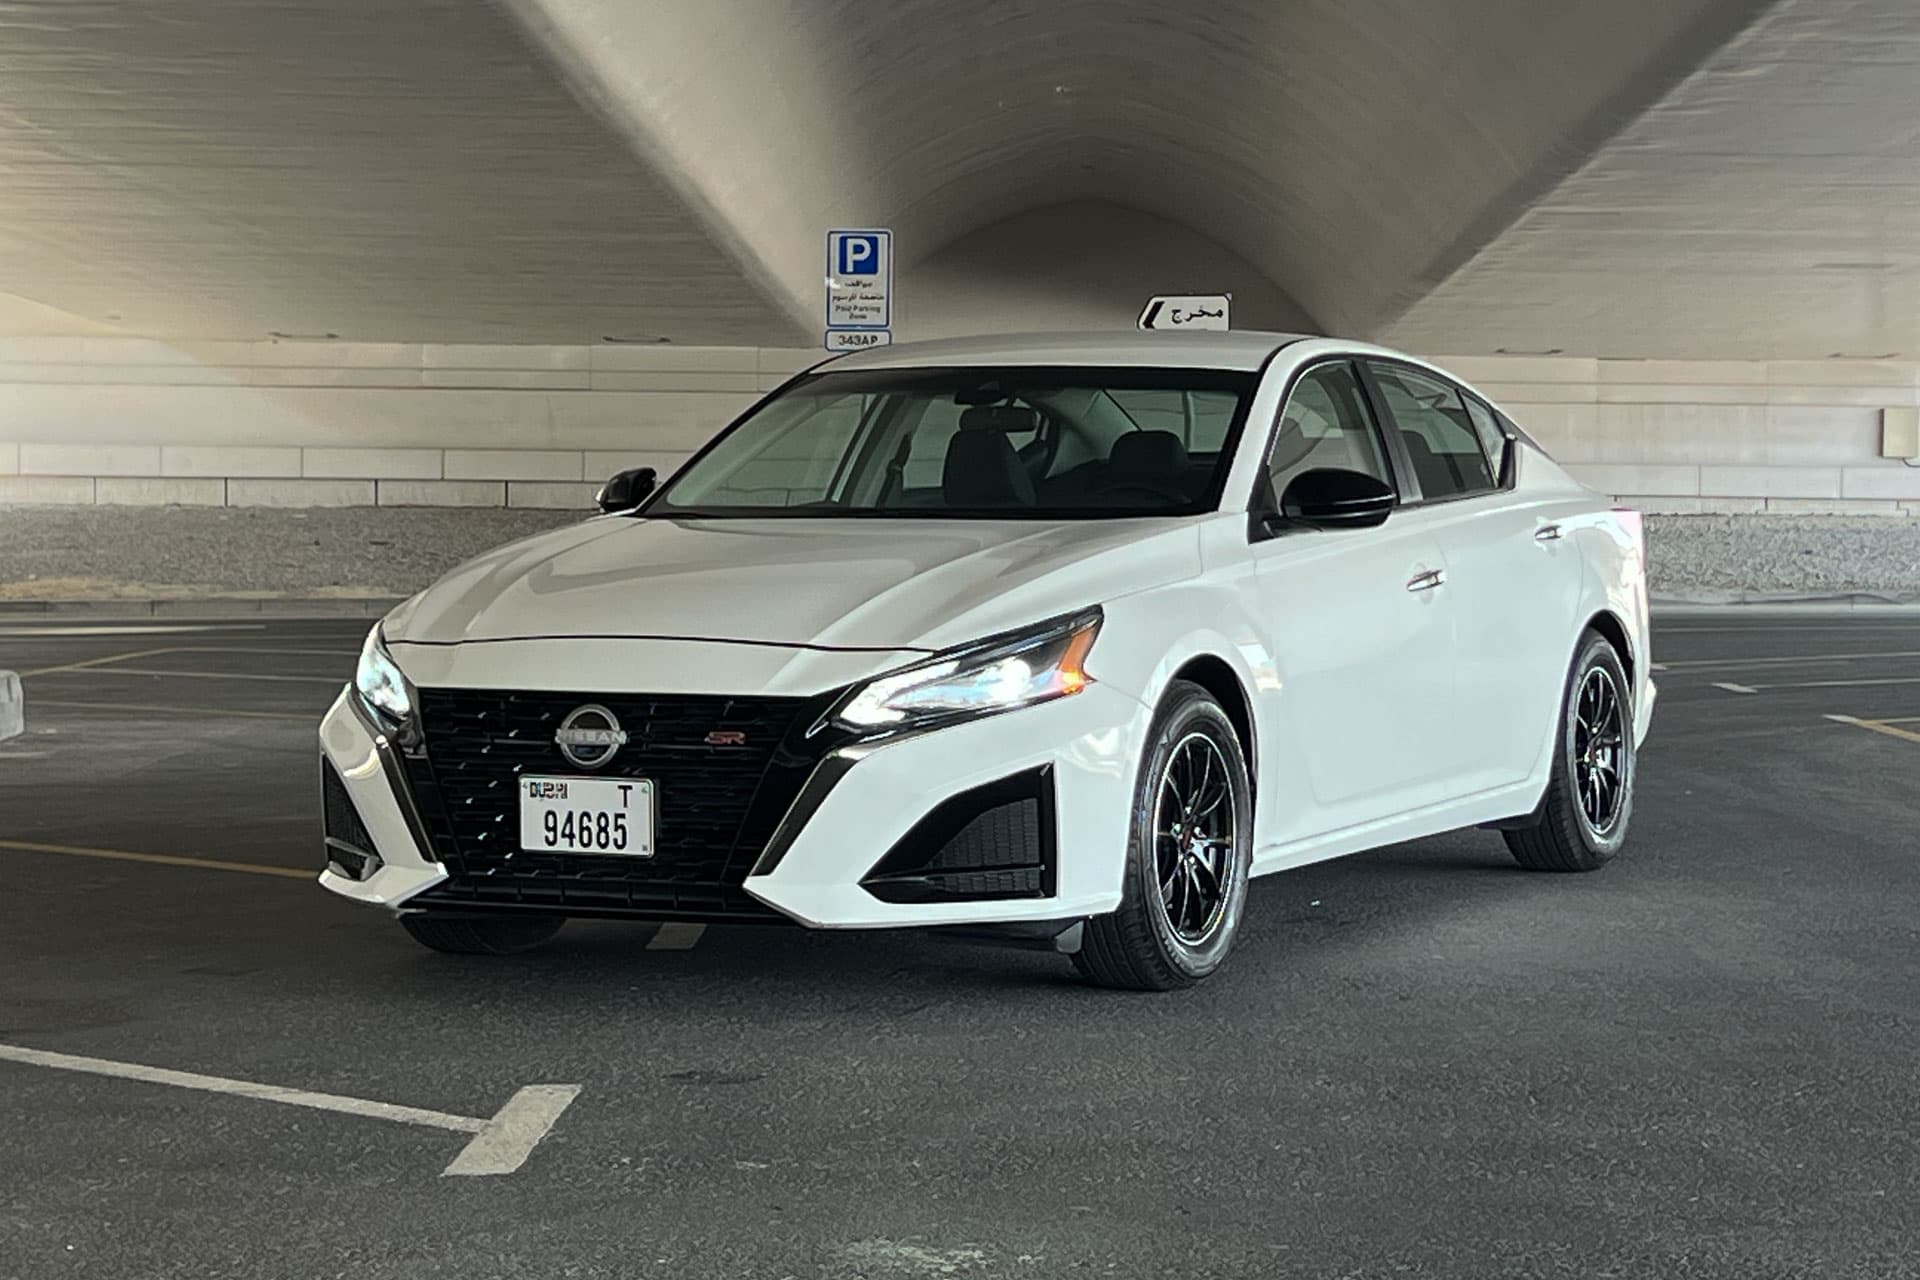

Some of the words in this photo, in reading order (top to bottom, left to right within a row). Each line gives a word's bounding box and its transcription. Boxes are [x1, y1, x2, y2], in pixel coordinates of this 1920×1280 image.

[1171, 305, 1223, 324] مخرج
[838, 335, 878, 346] 343AP
[555, 728, 627, 745] NISSAN
[704, 731, 745, 745] SR
[617, 785, 633, 808] T
[544, 810, 628, 849] 94685
